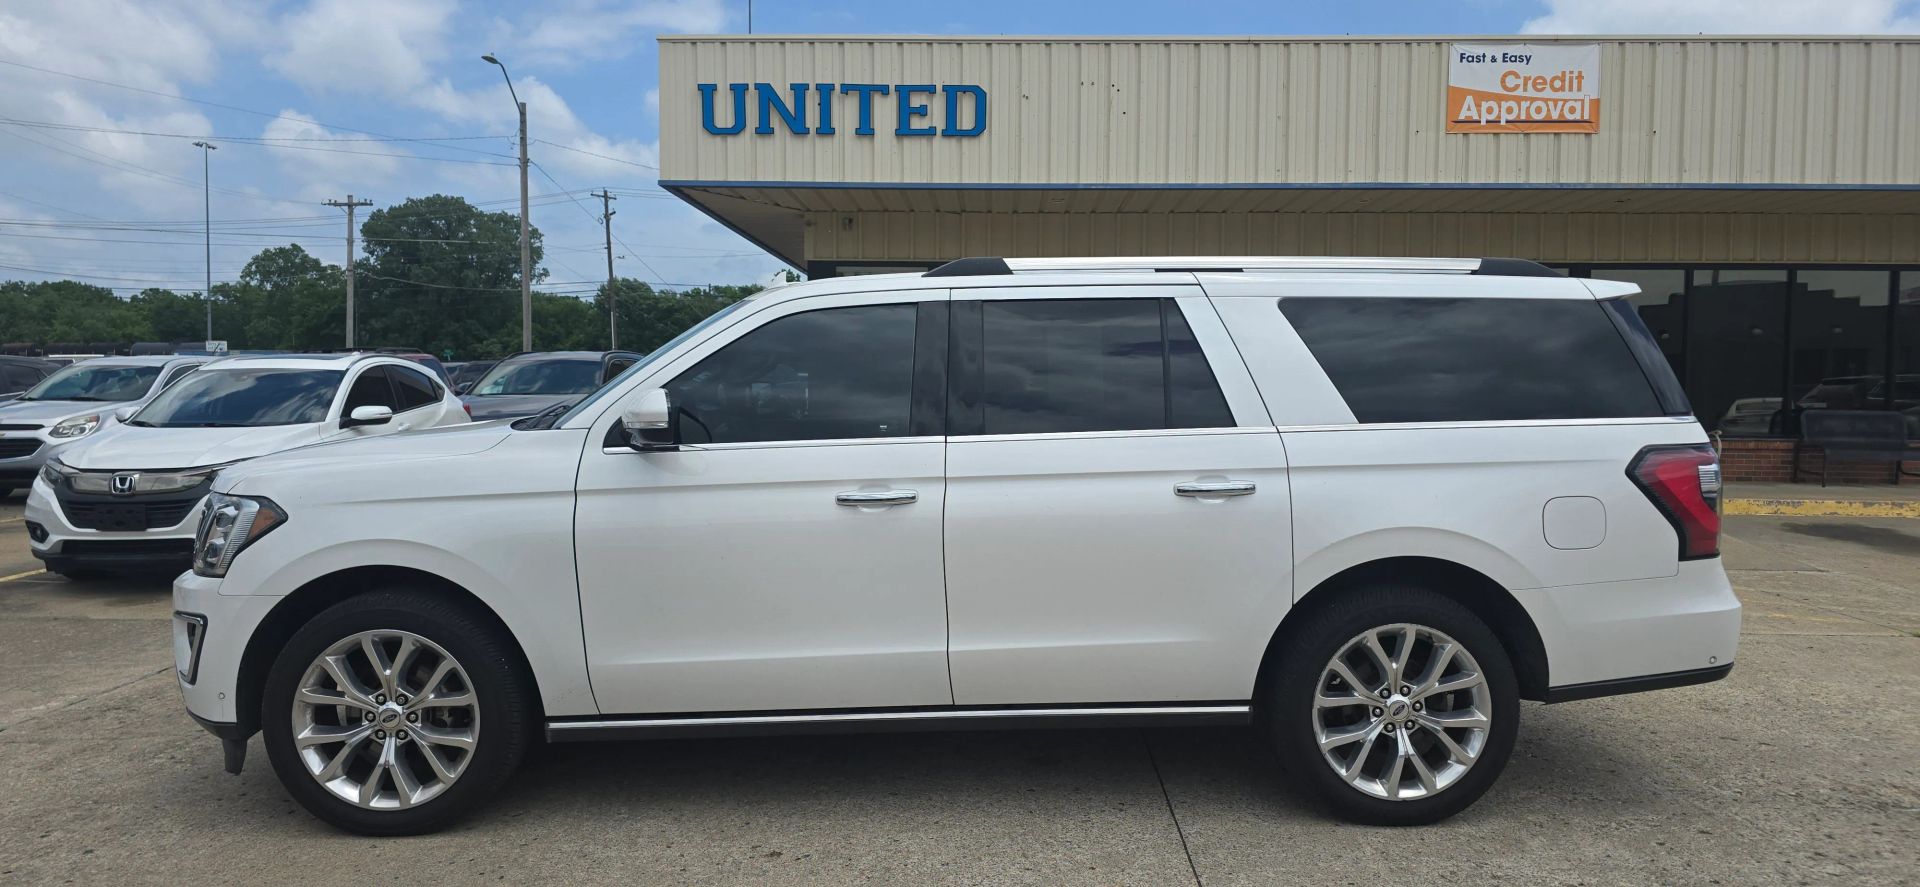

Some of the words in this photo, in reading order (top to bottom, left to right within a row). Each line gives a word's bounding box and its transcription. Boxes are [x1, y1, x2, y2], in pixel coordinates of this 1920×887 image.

[1459, 52, 1486, 63] Fast
[1490, 54, 1498, 63] &
[1502, 52, 1532, 65] Easy
[1500, 70, 1585, 93] Credit
[697, 82, 988, 136] UNITED
[1458, 94, 1591, 125] Approval
